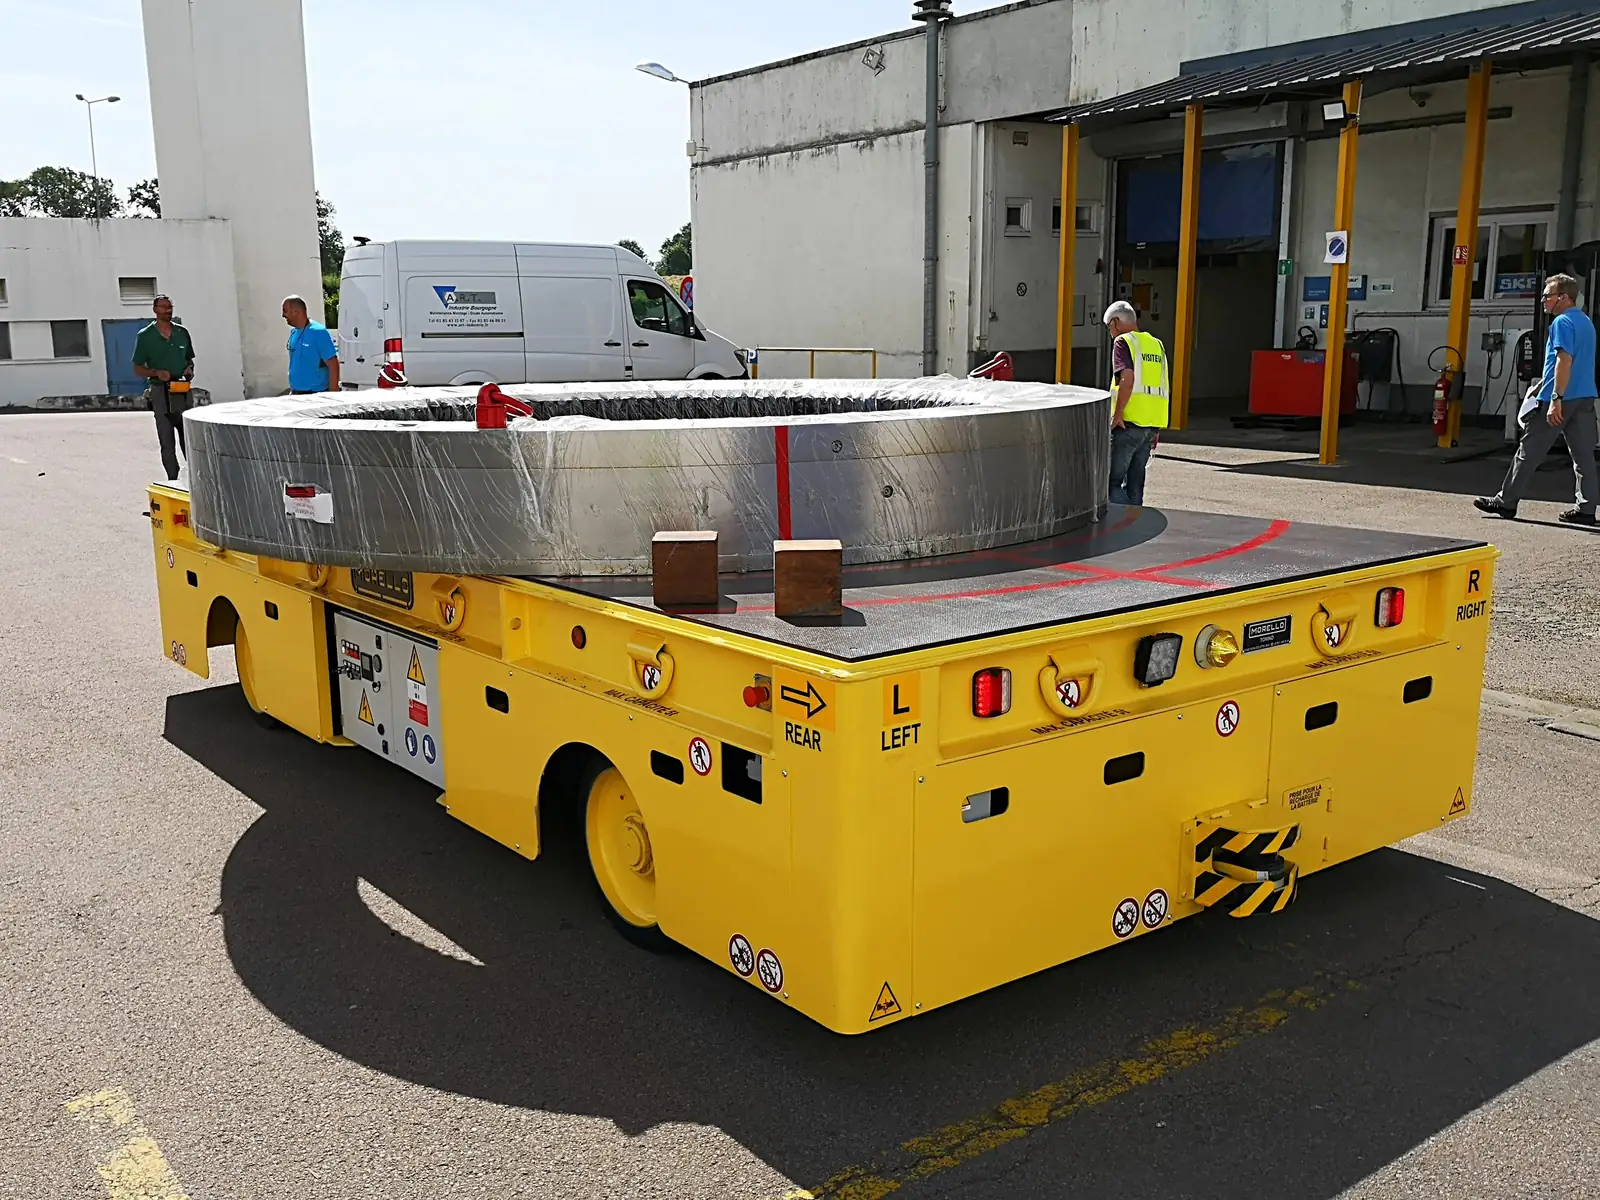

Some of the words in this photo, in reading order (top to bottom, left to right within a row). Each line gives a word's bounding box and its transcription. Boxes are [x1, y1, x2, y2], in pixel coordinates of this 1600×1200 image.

[1500, 278, 1536, 290] SKF
[1141, 353, 1162, 364] VISITEU
[1468, 569, 1480, 593] R
[1456, 600, 1487, 622] RIGHT
[1250, 621, 1285, 635] MORELLO
[893, 684, 910, 715] L
[785, 721, 821, 752] REAR
[881, 722, 921, 752] LEFT
